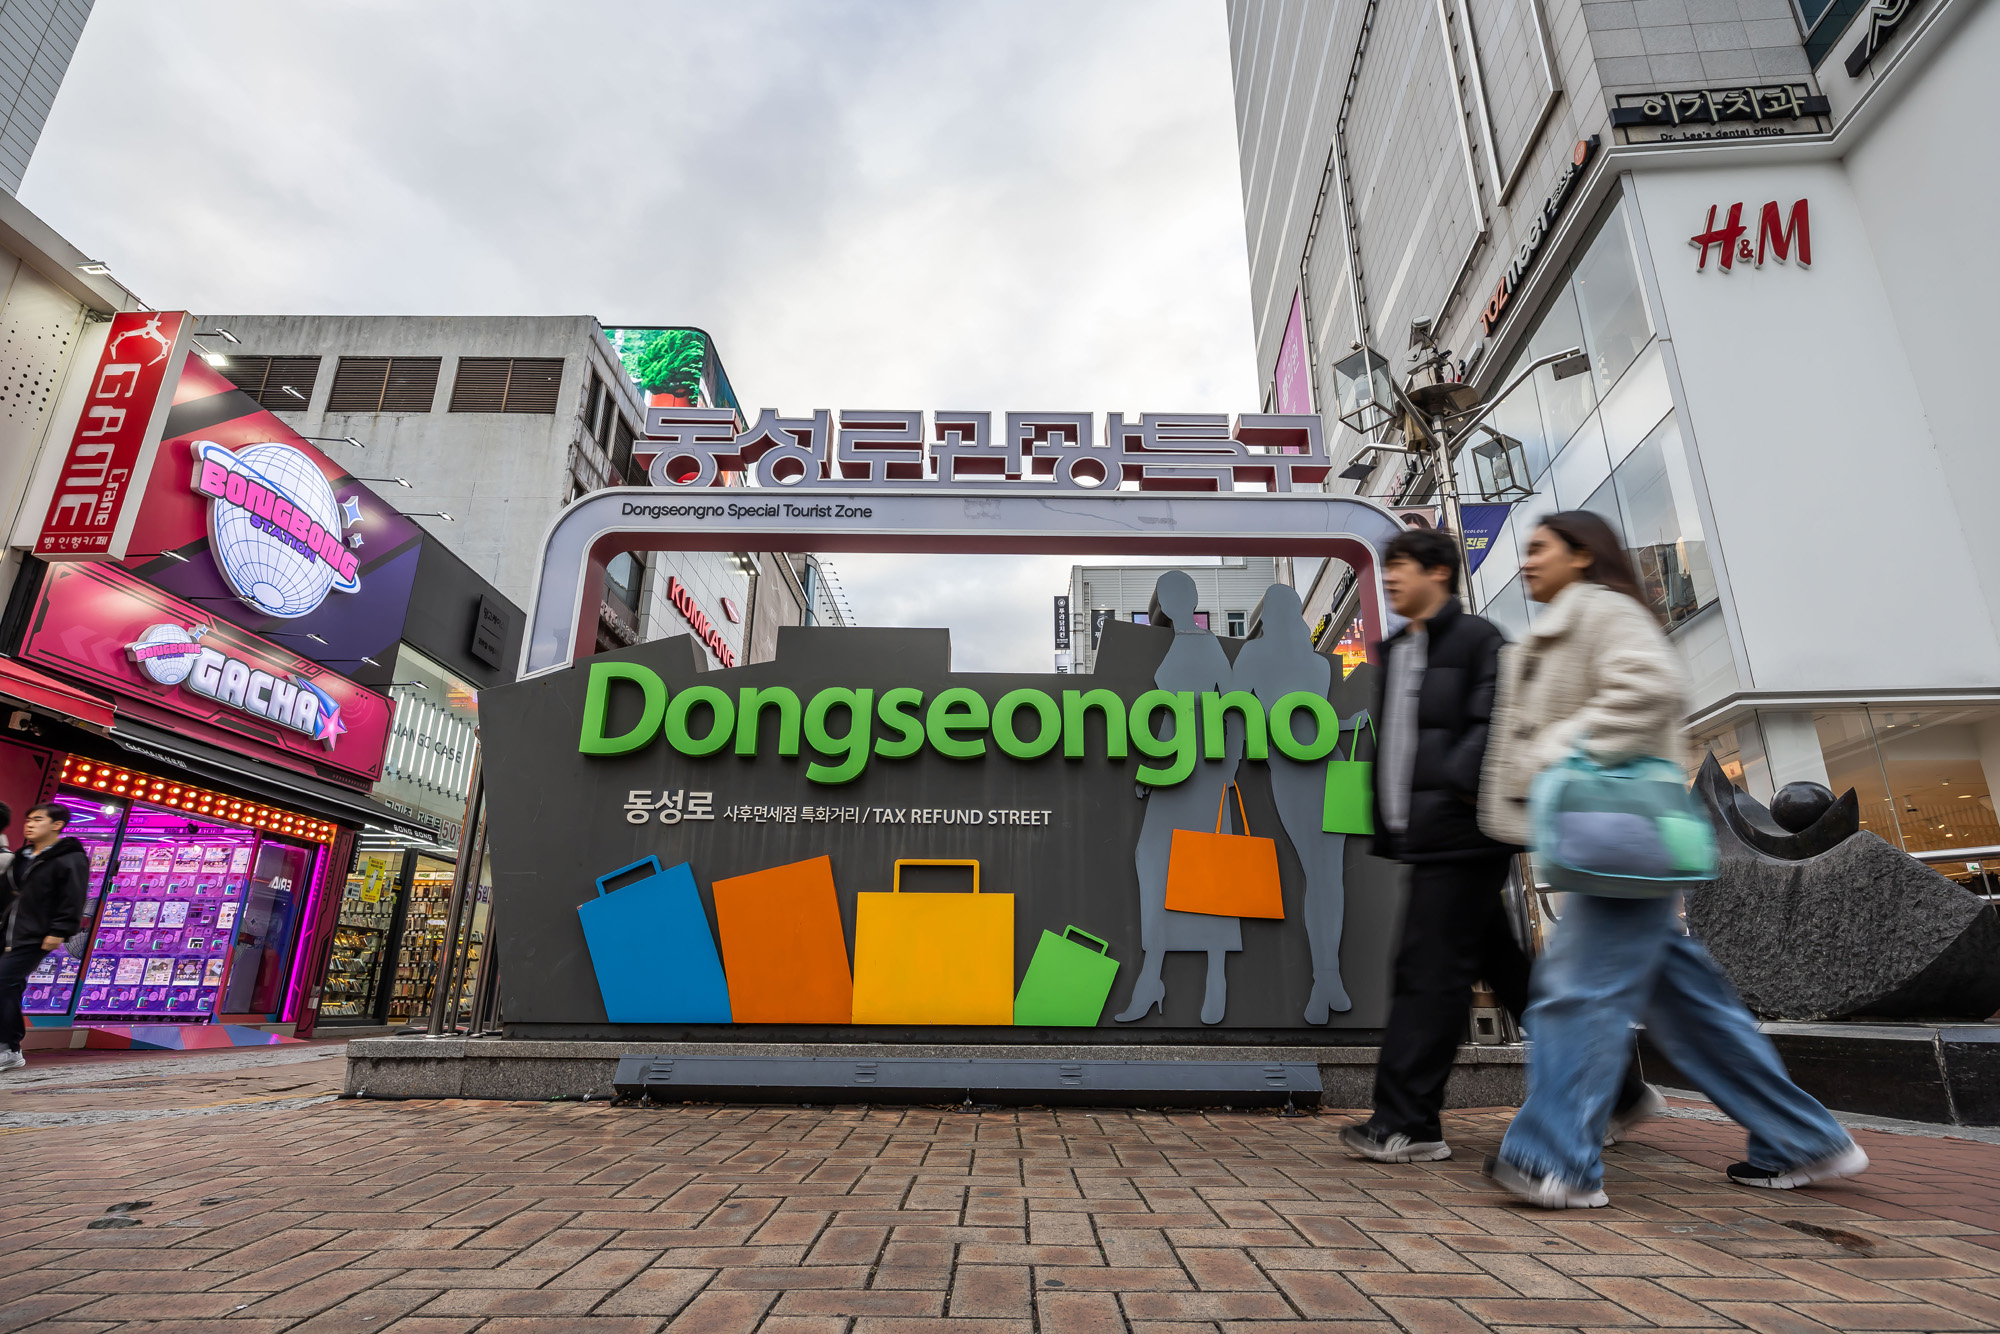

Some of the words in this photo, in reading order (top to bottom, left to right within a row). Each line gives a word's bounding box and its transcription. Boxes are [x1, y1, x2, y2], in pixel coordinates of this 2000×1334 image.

[1642, 84, 1805, 126] 이가치과
[1660, 133, 1676, 141] Dr.
[1683, 130, 1712, 139] Lee's
[1715, 128, 1750, 138] dental
[1753, 126, 1785, 136] office
[1688, 198, 1812, 273] H&M
[51, 362, 141, 526] GAME
[94, 468, 129, 526] Crane
[621, 502, 725, 519] Dongseongno
[727, 502, 781, 519] Special
[783, 503, 833, 517] Tourist
[835, 504, 872, 518] Zone
[250, 513, 317, 564] STATION
[1465, 537, 1489, 550] 진료
[667, 575, 736, 668] KUMKANG
[188, 645, 320, 735] GACHA
[391, 720, 432, 750] MANGO
[434, 741, 463, 764] CASE
[578, 661, 1340, 786] Dongseongno
[623, 789, 715, 825] 동성로
[723, 805, 798, 823] 사후면세점
[800, 806, 859, 823] 특화거리
[873, 808, 907, 824] TAX
[911, 808, 984, 825] REFUND
[987, 810, 1053, 825] STREET
[393, 824, 414, 836] BONG
[414, 830, 433, 841] BONG
[352, 840, 362, 872] MANGO
